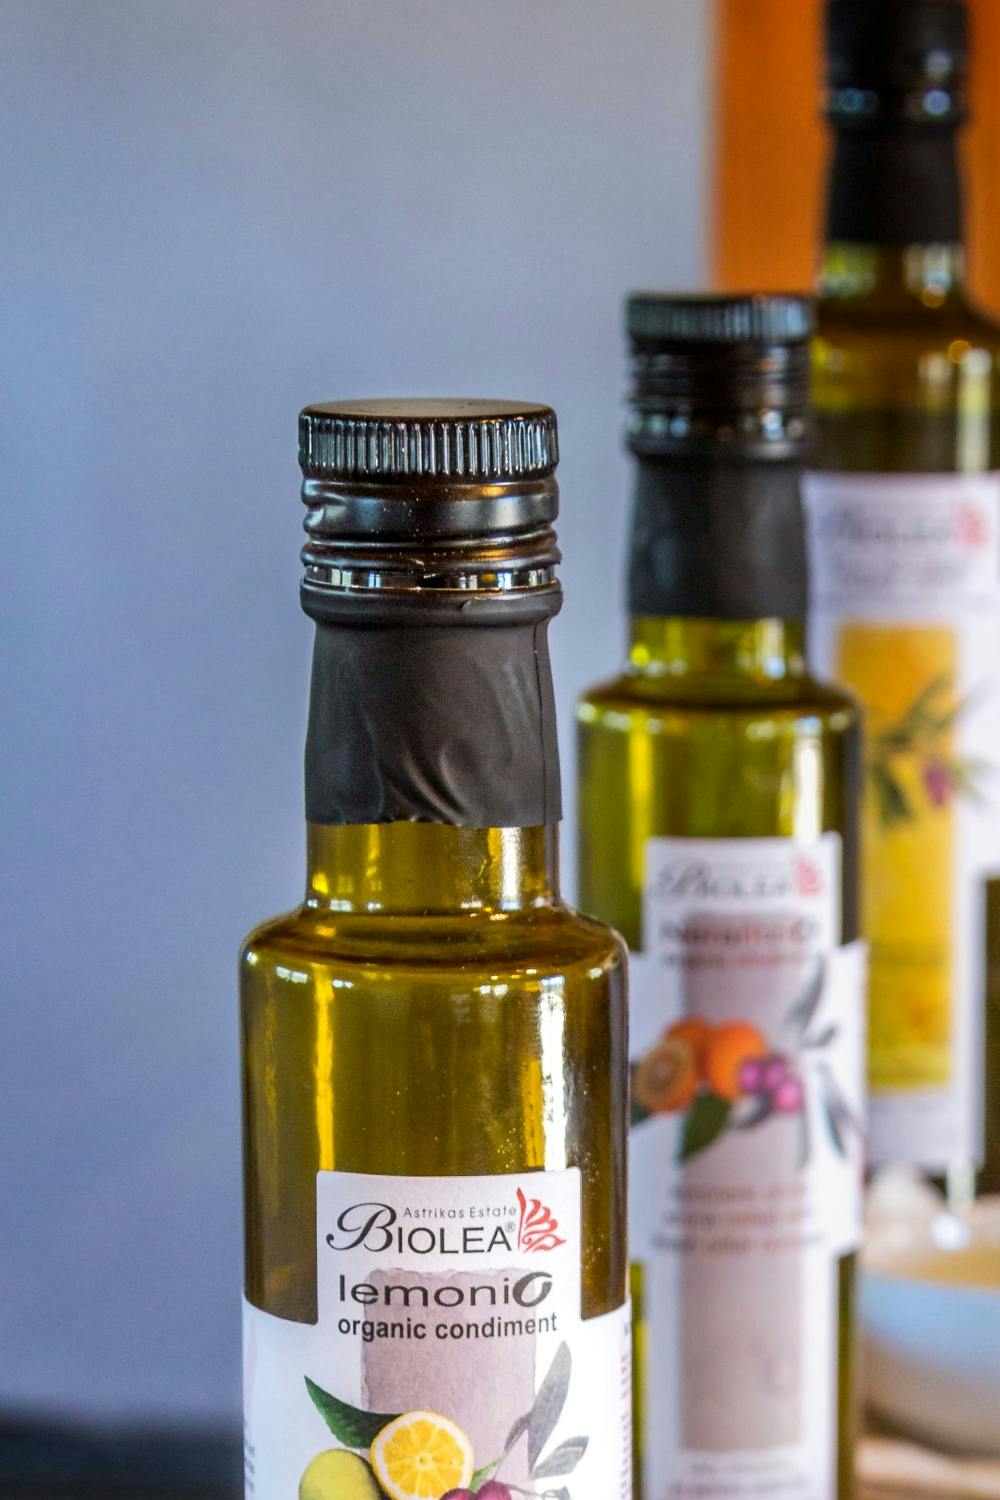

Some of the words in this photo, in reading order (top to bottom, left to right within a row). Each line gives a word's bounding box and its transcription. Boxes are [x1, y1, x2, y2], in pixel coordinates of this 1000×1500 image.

[403, 1207, 465, 1219] Astrikas
[469, 1205, 517, 1219] Estate
[338, 1317, 427, 1343] organic
[435, 1312, 558, 1340] condiment
